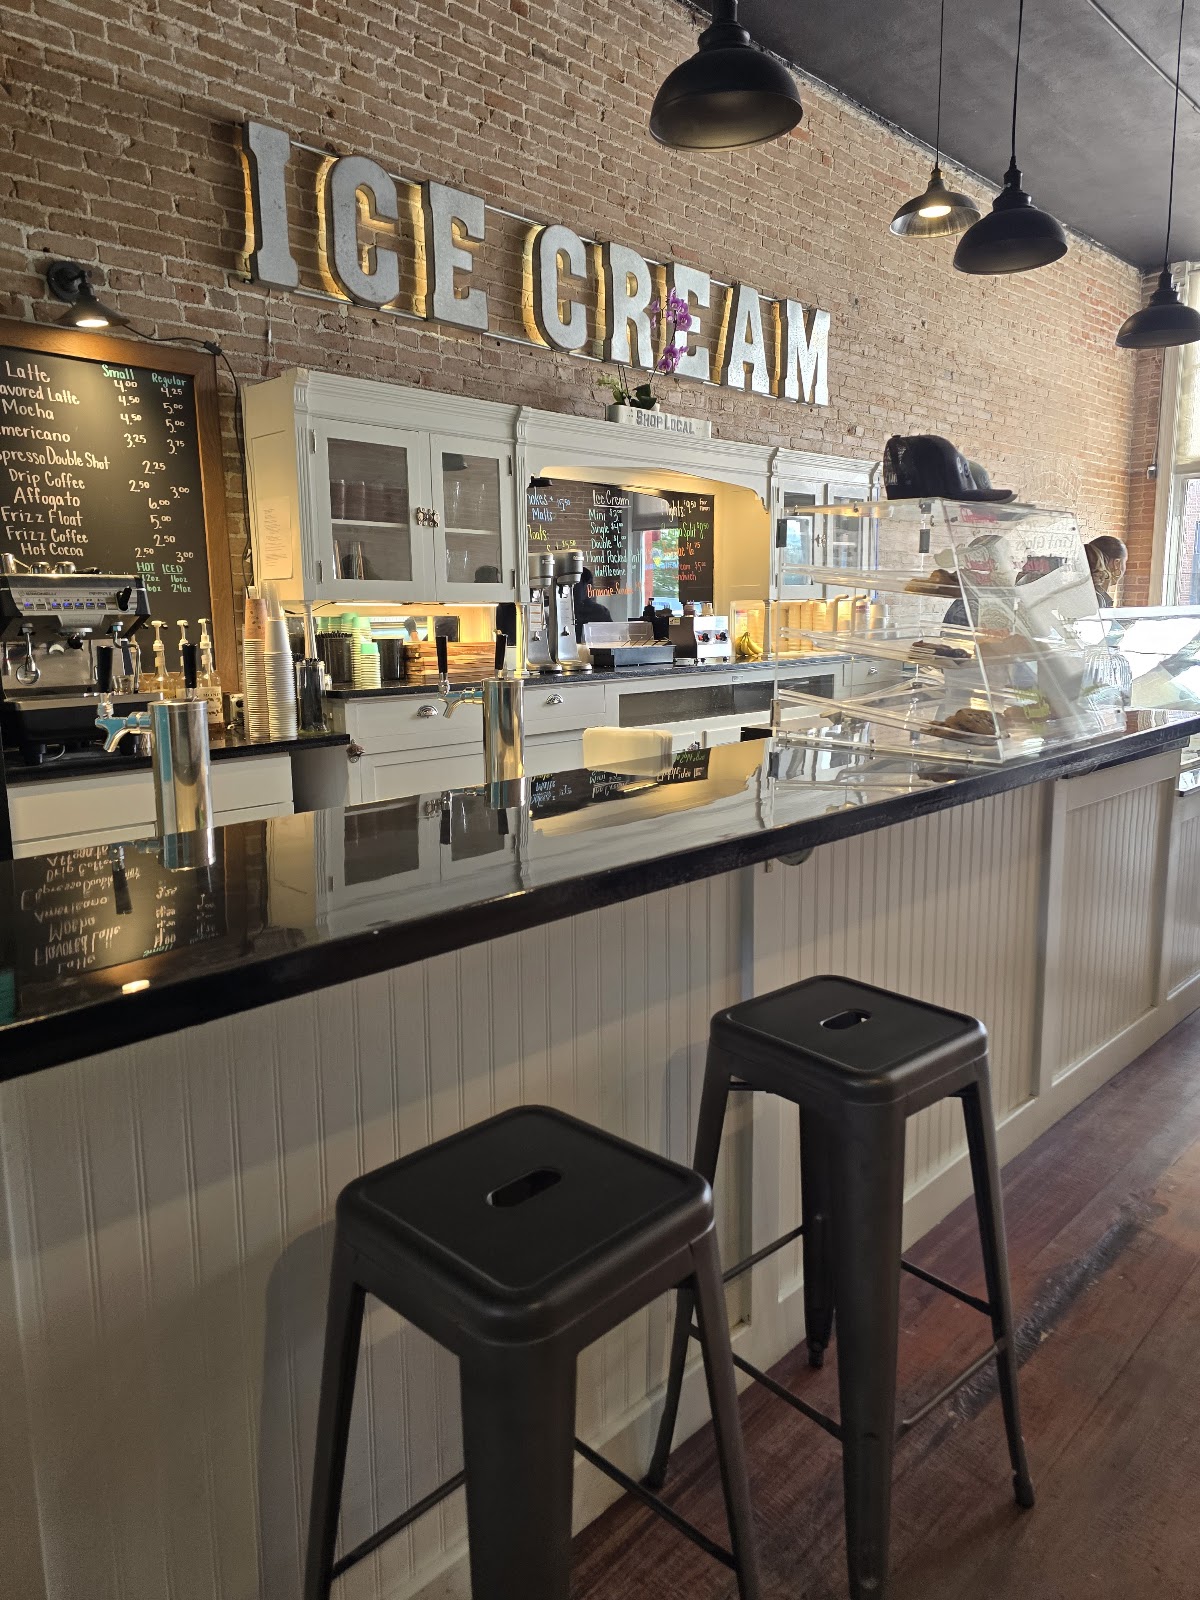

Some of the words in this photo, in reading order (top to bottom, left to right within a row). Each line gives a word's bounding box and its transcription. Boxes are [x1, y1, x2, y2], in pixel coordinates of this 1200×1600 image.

[242, 121, 489, 331] ICE
[532, 224, 831, 406] CREAM
[5, 360, 51, 383] Latte
[102, 364, 134, 380] Small
[151, 373, 187, 388] Regular
[47, 387, 80, 405] Latte
[2, 398, 55, 420] Mocha
[0, 425, 71, 443] mericano
[46, 445, 84, 467] Double
[85, 451, 110, 470] Shot
[8, 468, 41, 488] Drip
[44, 470, 86, 490] Coffee
[13, 486, 81, 512] Affogato
[606, 489, 630, 507] Cream
[0, 506, 45, 523] Frizz
[48, 510, 84, 527] Float
[588, 508, 606, 522] Mini
[5, 525, 47, 541] Frizz
[50, 527, 89, 544] Coffee
[590, 522, 610, 539] Single
[682, 521, 696, 541] Split
[20, 542, 46, 555] Hot
[49, 542, 84, 557] Cocoa
[591, 537, 613, 550] Double
[585, 549, 605, 563] Hand
[136, 561, 155, 573] HOT
[161, 563, 184, 573] ICED
[146, 583, 162, 592] 6oz
[170, 583, 192, 594] 24oz
[586, 583, 614, 599] Brownie
